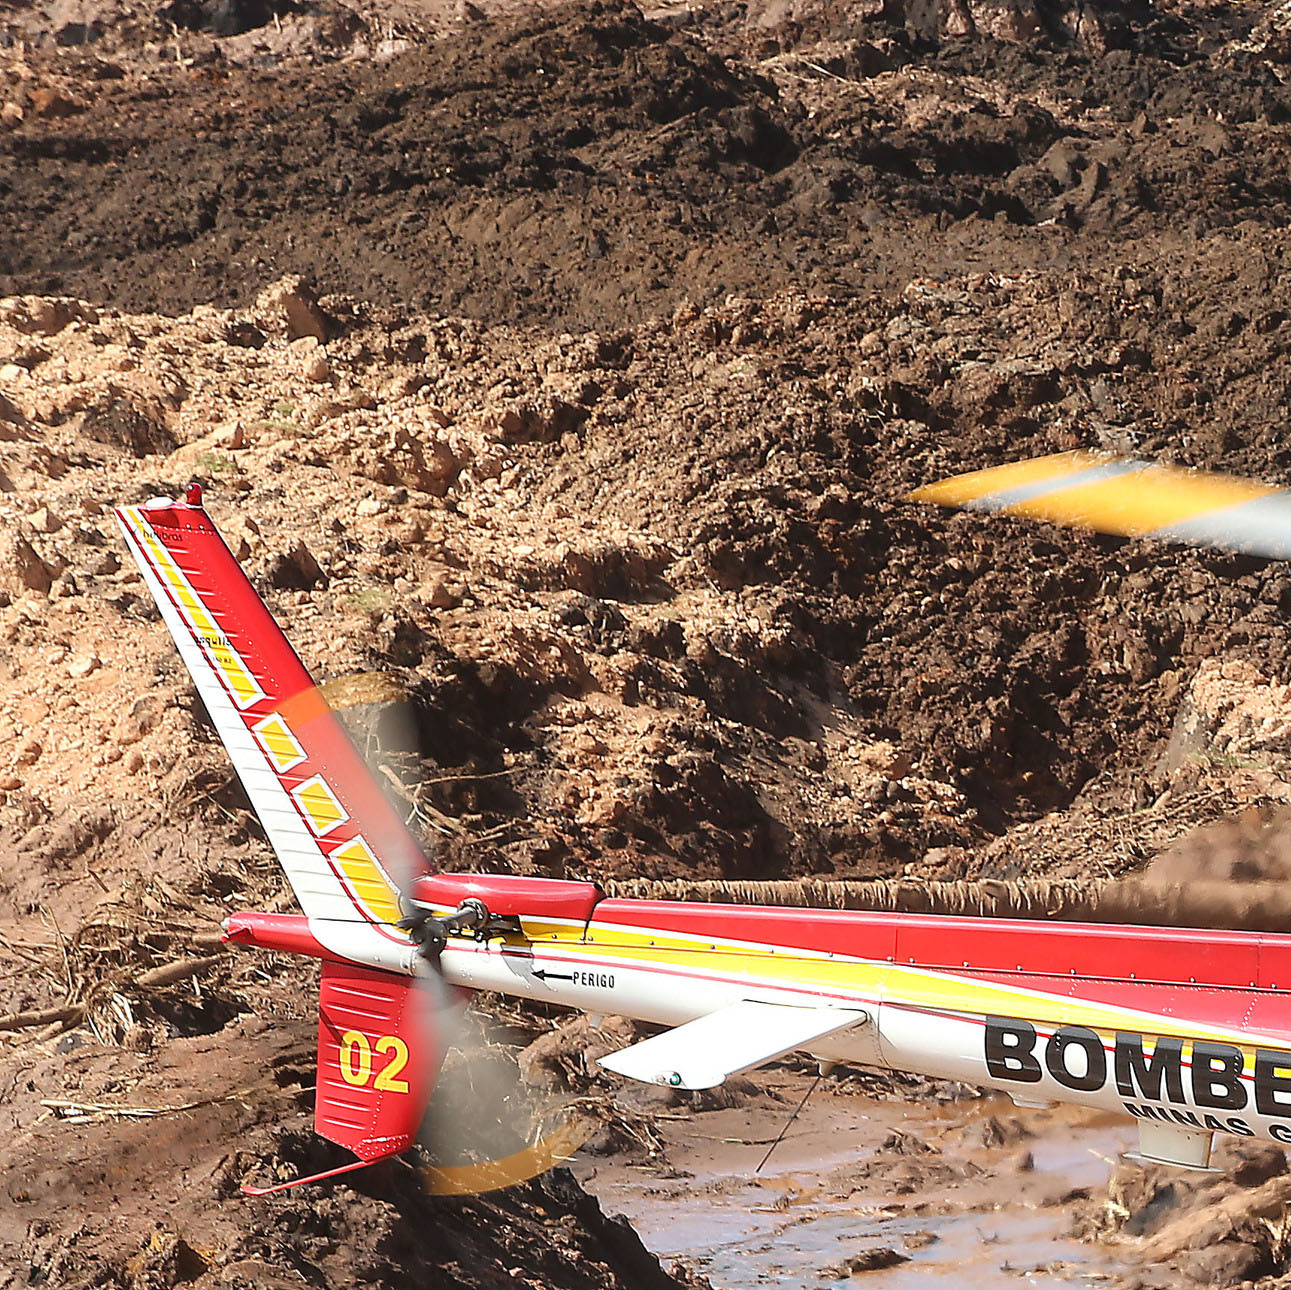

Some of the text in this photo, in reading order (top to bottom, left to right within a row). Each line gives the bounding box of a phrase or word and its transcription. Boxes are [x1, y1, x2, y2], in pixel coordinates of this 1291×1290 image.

[572, 971, 615, 989] PERIGO
[339, 1029, 409, 1094] 02
[1123, 1102, 1255, 1138] MINAS
